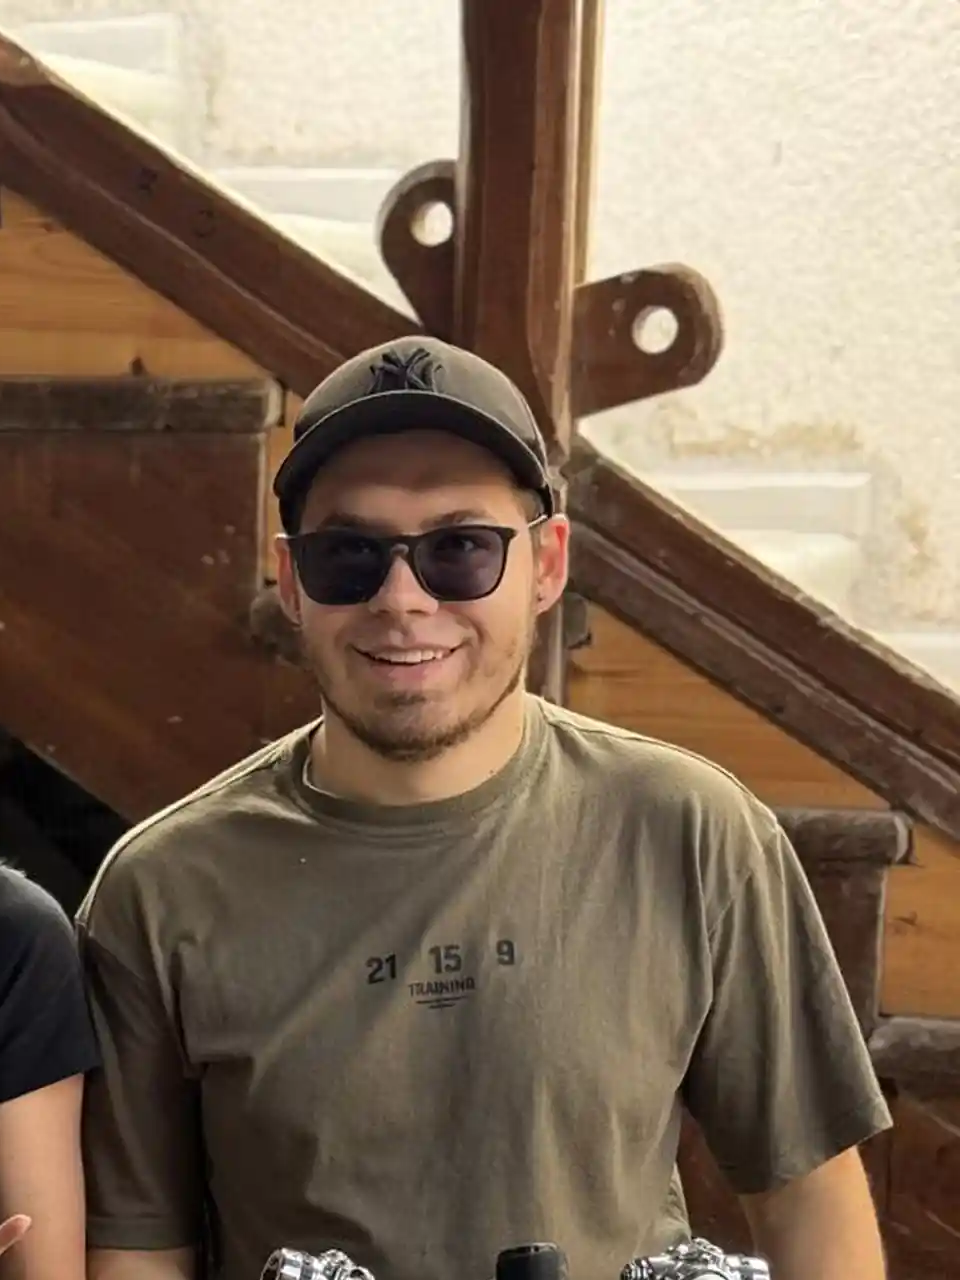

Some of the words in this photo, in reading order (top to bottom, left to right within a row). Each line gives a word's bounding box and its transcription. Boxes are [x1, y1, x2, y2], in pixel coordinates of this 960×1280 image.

[365, 954, 397, 985] 21
[429, 944, 462, 974] 15
[496, 940, 515, 966] 9
[408, 977, 476, 997] TRAINING
